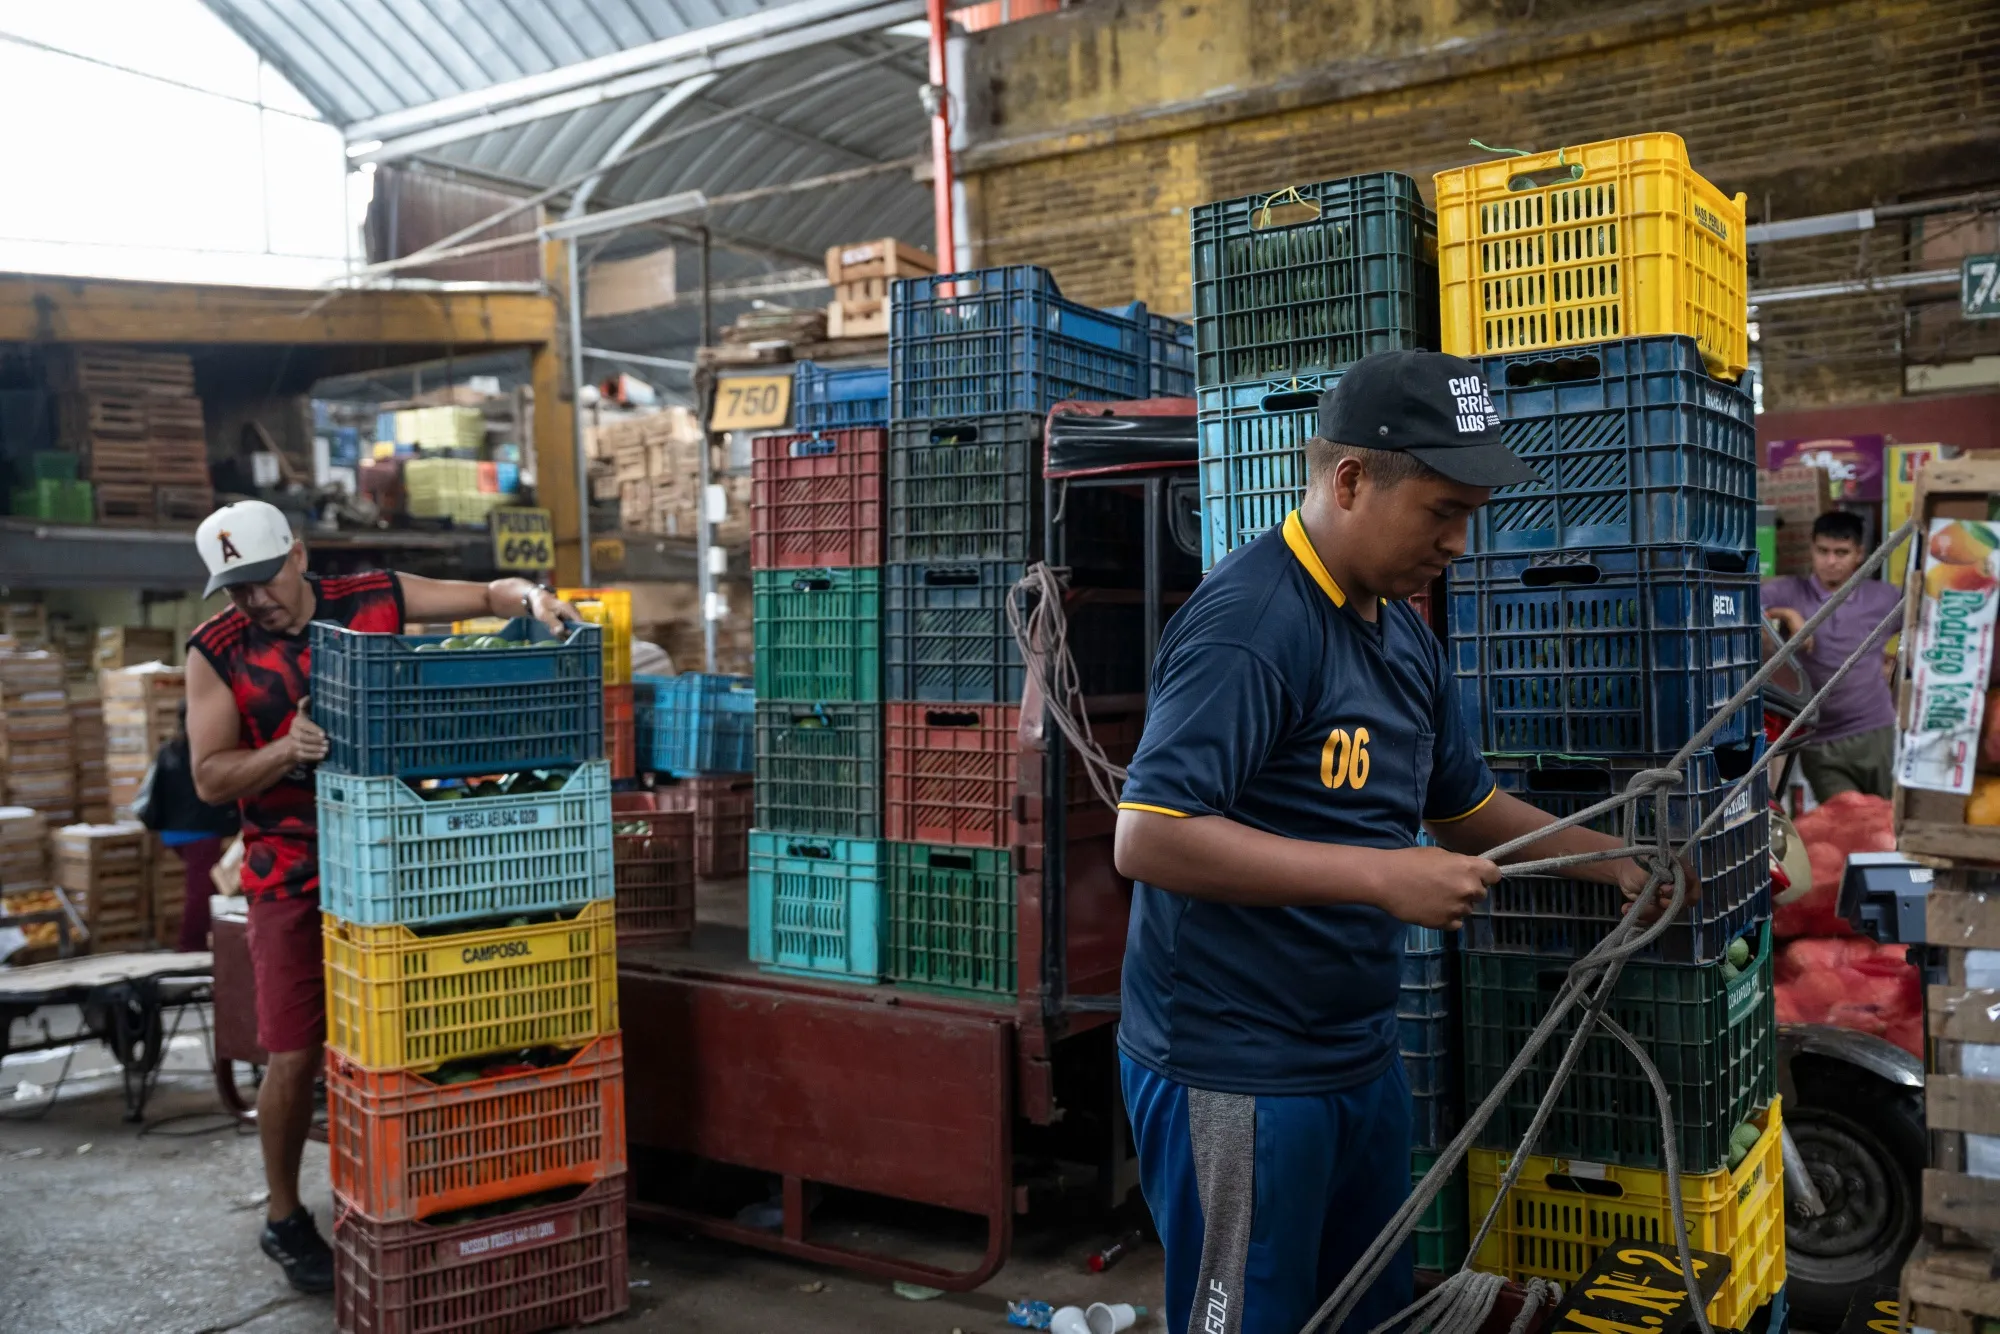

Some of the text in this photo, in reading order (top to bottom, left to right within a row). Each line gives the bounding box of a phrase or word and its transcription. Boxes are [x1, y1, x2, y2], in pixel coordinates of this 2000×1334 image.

[1448, 375, 1480, 396] CHO
[727, 383, 779, 418] 750
[1457, 395, 1484, 414] RRI
[1456, 414, 1486, 432] LLOS
[219, 531, 242, 564] A
[505, 538, 548, 563] 696
[1713, 594, 1735, 617] BETA
[1925, 590, 1983, 674] Rodrigo
[1320, 727, 1370, 790] 06
[447, 812, 486, 831] EMPRESA
[462, 940, 532, 964] CAMPOSOL
[1205, 1278, 1227, 1334] GOLF
